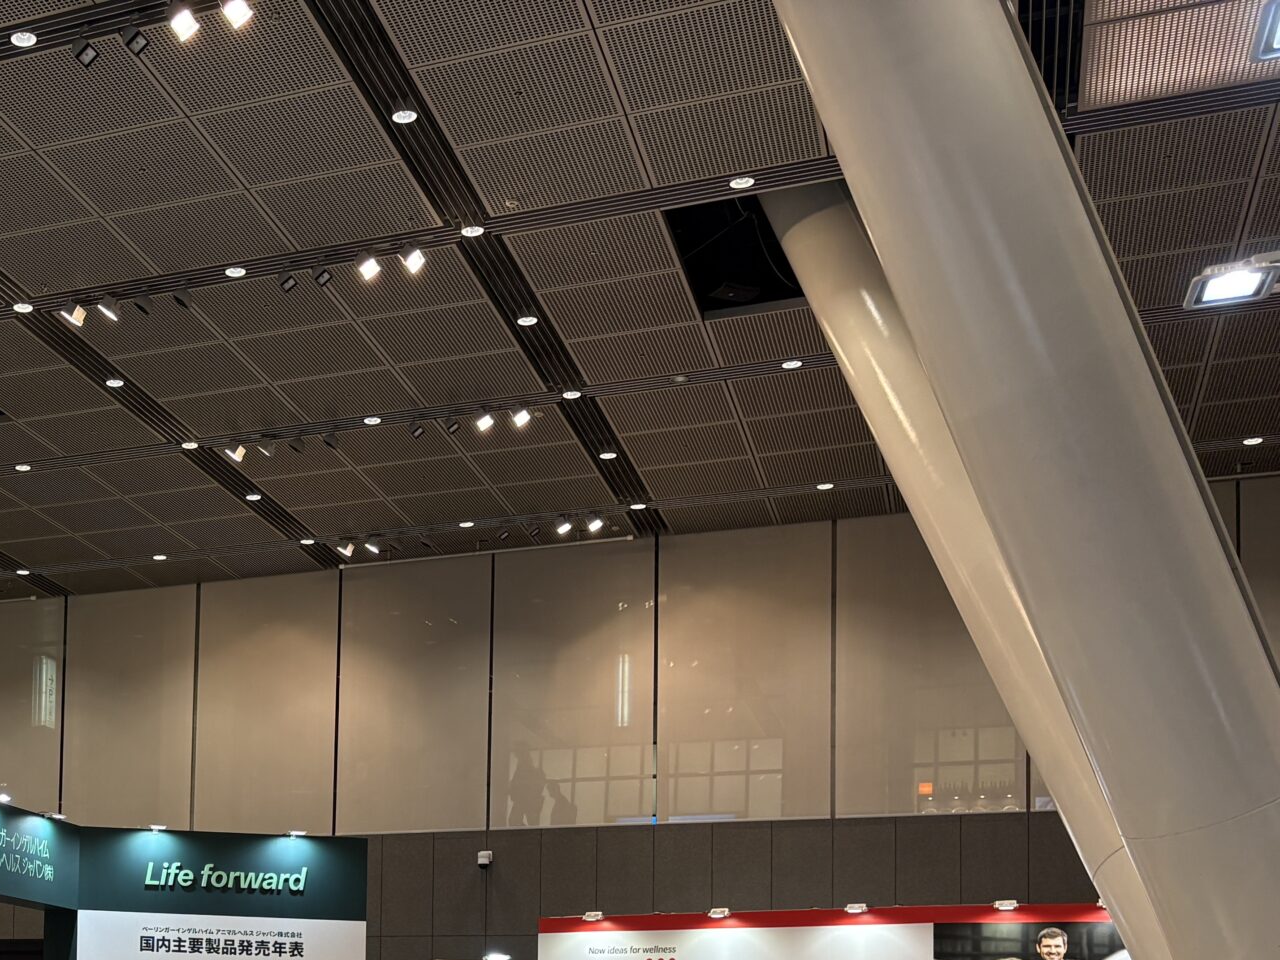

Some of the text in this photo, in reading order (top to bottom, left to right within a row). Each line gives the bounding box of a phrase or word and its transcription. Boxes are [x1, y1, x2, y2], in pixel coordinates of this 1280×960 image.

[144, 862, 308, 891] Life forward
[139, 935, 305, 958] 国内主要製品発売年表
[589, 945, 677, 955] Now ideas for wellness
